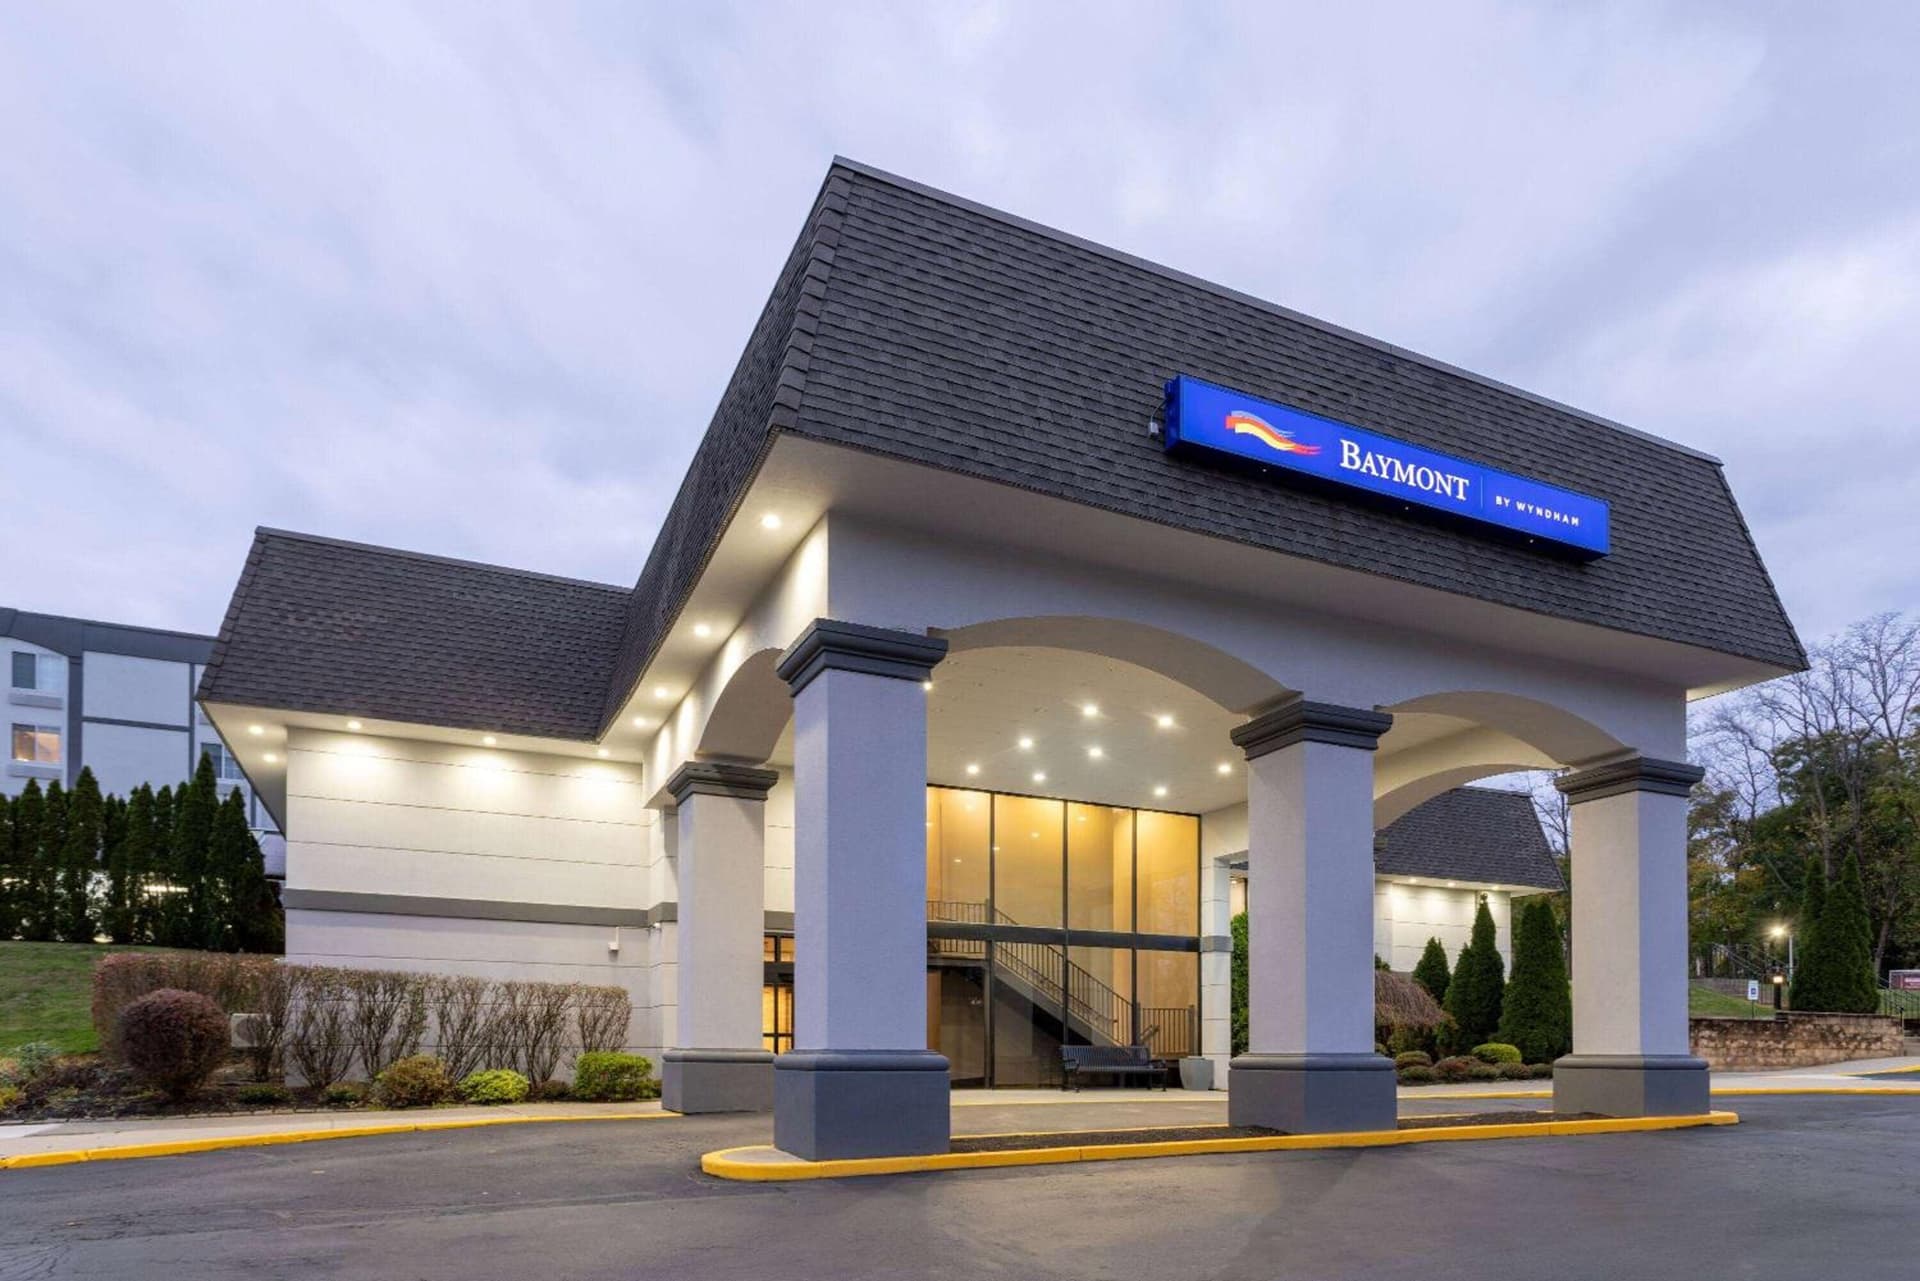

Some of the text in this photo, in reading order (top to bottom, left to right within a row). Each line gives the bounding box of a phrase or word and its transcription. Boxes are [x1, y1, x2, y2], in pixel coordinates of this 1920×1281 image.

[1339, 439, 1470, 501] BAYMONT
[1495, 495, 1580, 527] BY WYNDHAM
